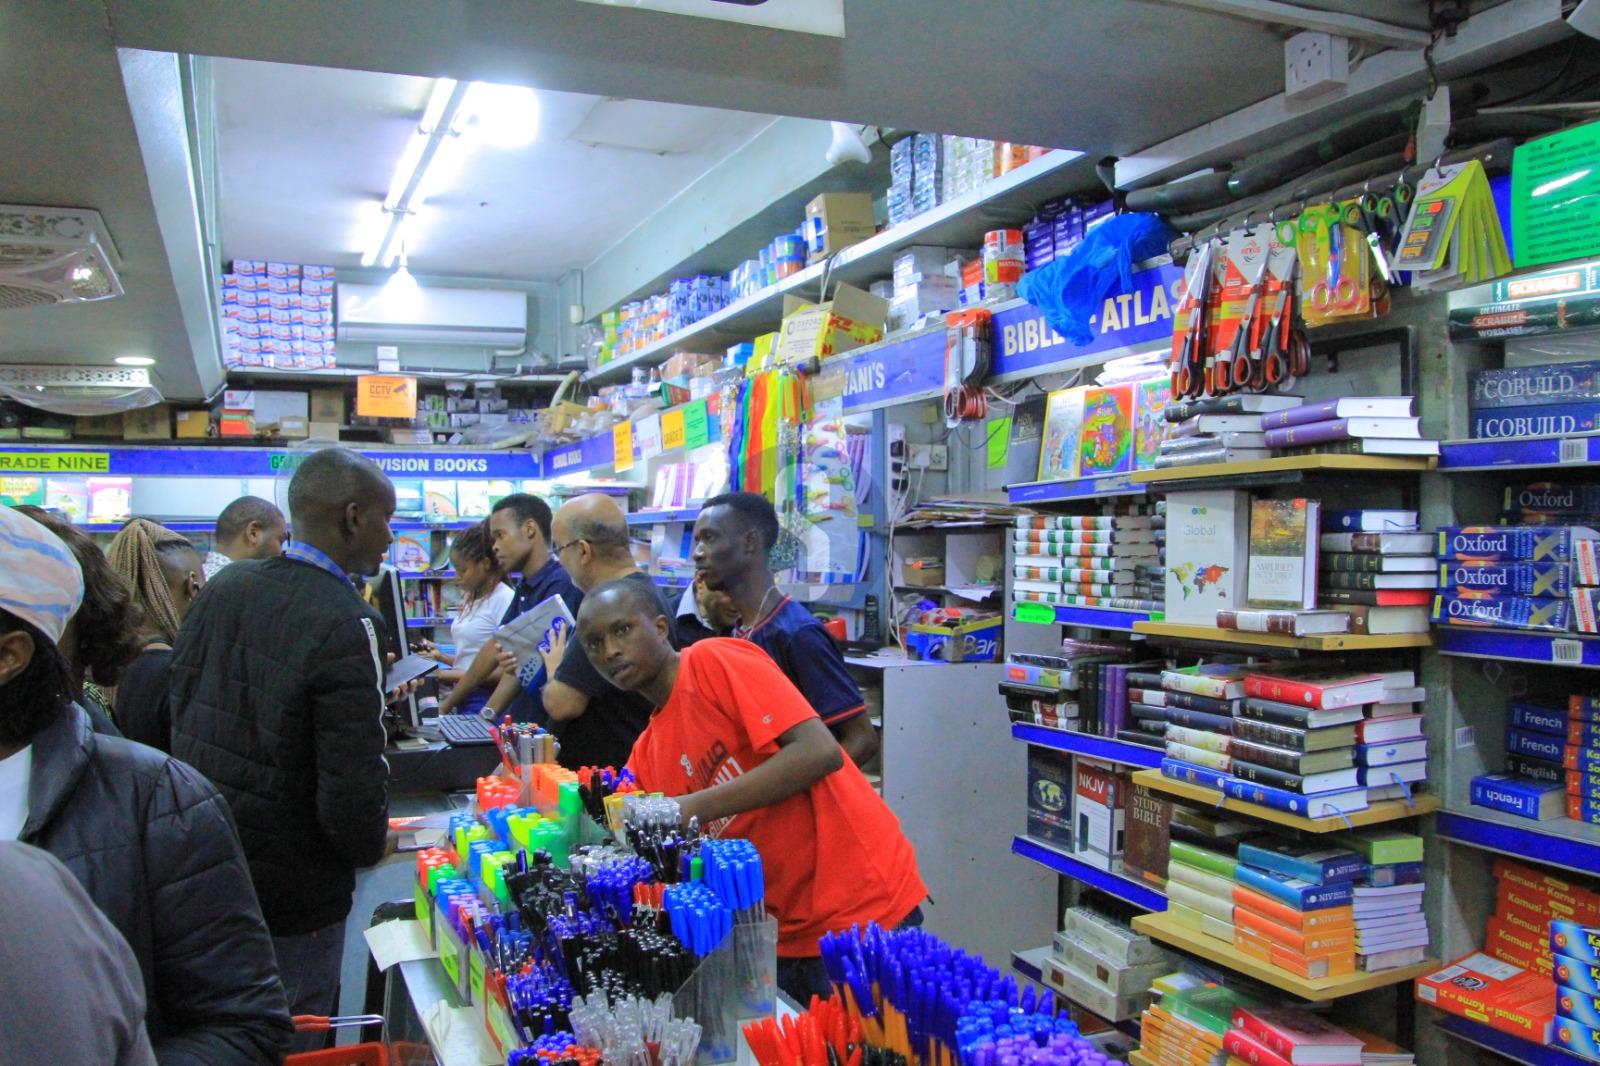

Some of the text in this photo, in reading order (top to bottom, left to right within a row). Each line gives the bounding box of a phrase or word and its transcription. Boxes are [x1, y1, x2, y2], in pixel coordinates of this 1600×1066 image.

[369, 385, 392, 395] CCTV
[1484, 375, 1575, 399] COBUILD
[1486, 415, 1576, 438] COBUILD
[0, 456, 107, 469] RADE NINE
[374, 458, 488, 472] VISION BOOKS
[1519, 490, 1574, 507] Oxford
[1183, 524, 1216, 536] Global
[1453, 535, 1508, 552] Oxford
[1455, 568, 1508, 585] Oxford
[1448, 600, 1503, 619] Oxford
[1524, 711, 1562, 729] French
[1521, 737, 1559, 755] French
[1520, 763, 1557, 781] English
[1079, 773, 1105, 795] NKJV
[1133, 795, 1162, 814] STUDY
[1486, 789, 1522, 809] French
[1133, 807, 1162, 828] BIBLE
[1503, 869, 1537, 890] Kamusi
[1319, 893, 1334, 902] NIV
[1507, 891, 1542, 913] Kamusi
[1506, 911, 1541, 934] Kamusi
[1498, 929, 1533, 951] Kamusi
[1495, 947, 1530, 969] Kamusi
[1494, 1009, 1532, 1030] Kamusi
